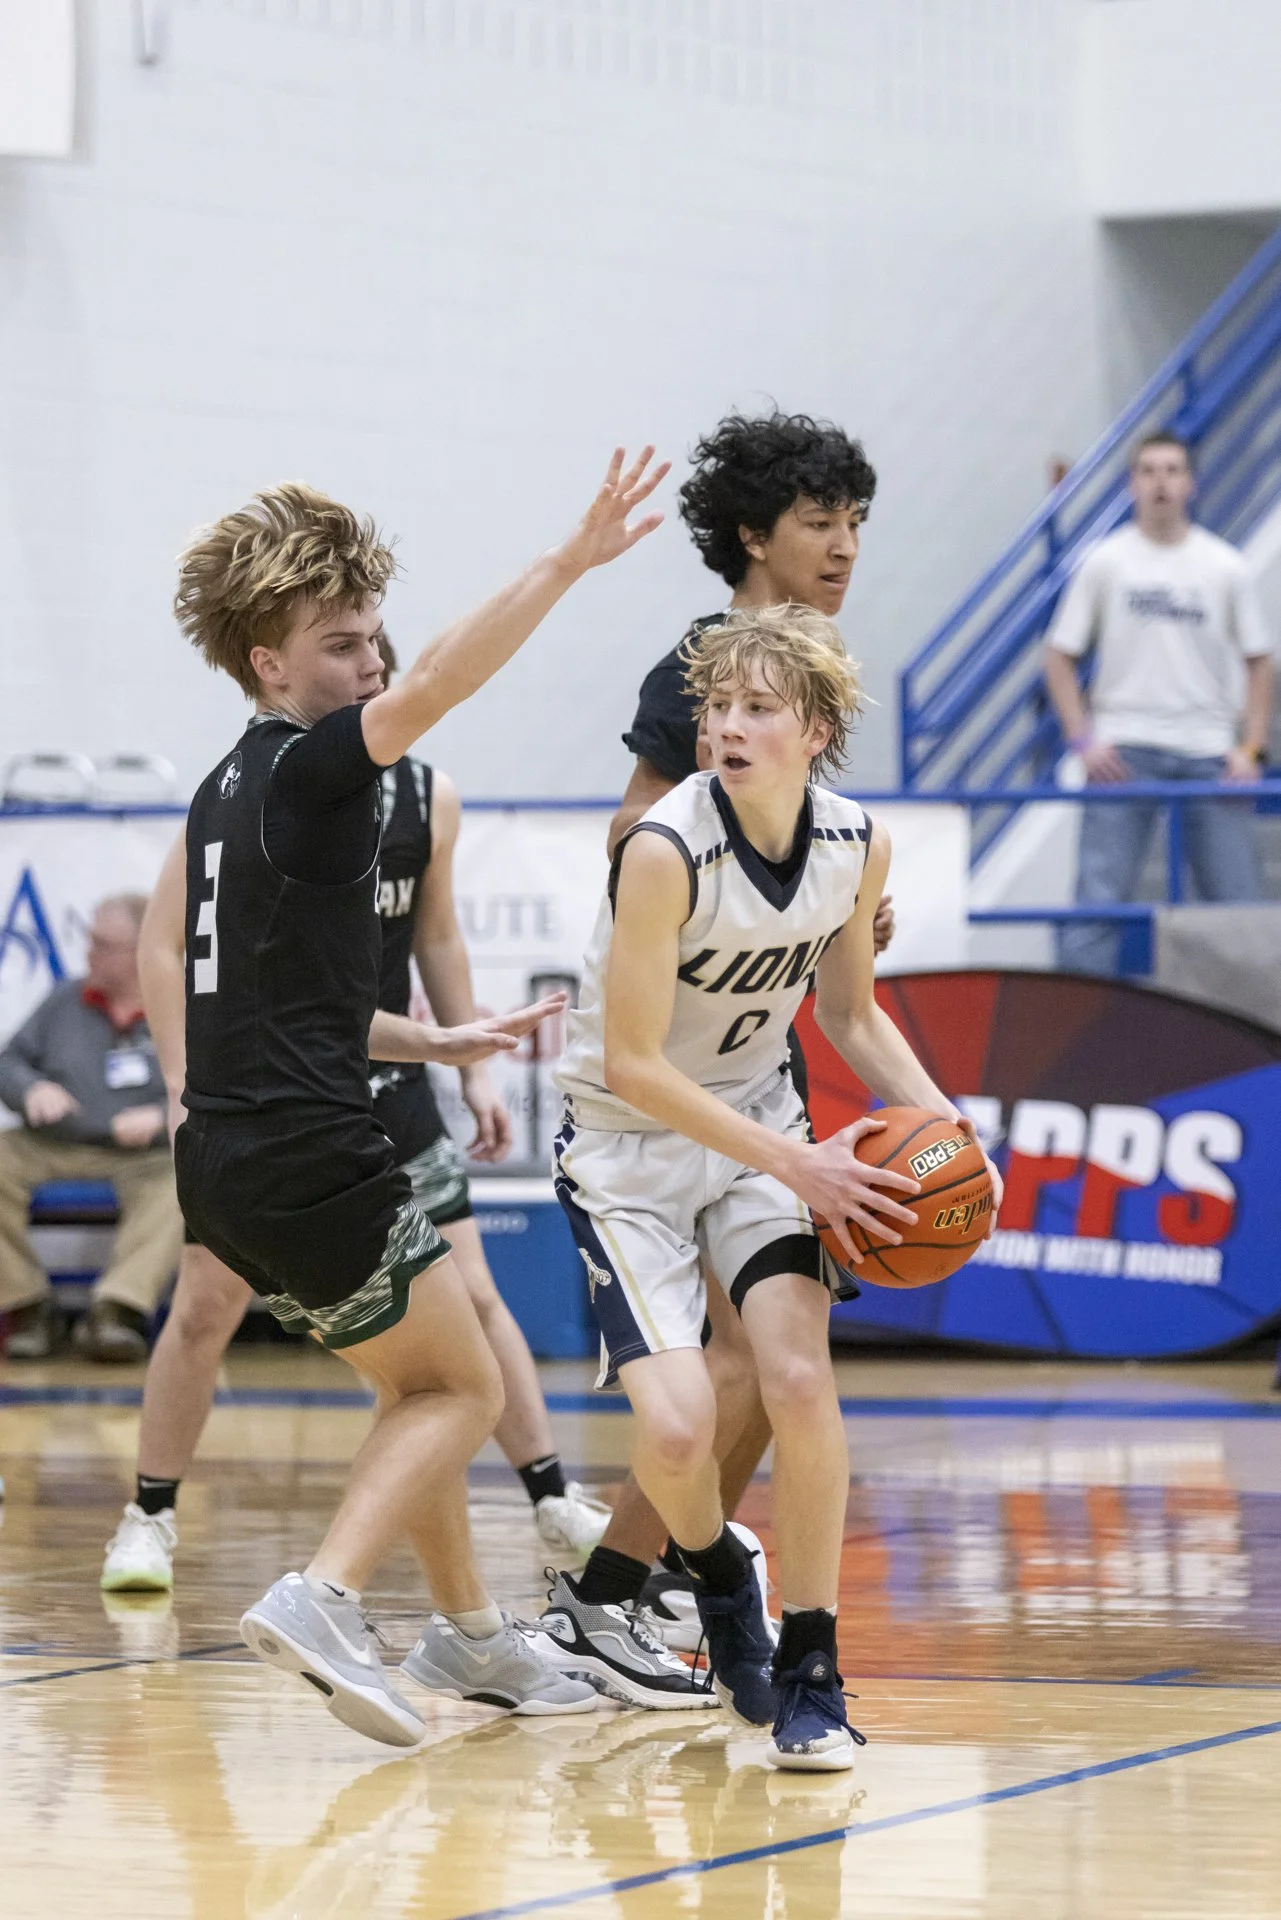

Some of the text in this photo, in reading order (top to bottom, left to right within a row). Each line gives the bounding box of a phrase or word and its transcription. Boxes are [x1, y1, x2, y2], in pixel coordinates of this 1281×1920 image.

[194, 841, 223, 994] 3
[717, 1009, 770, 1055] 0
[911, 1143, 951, 1177] PRO
[933, 1192, 994, 1235] aden
